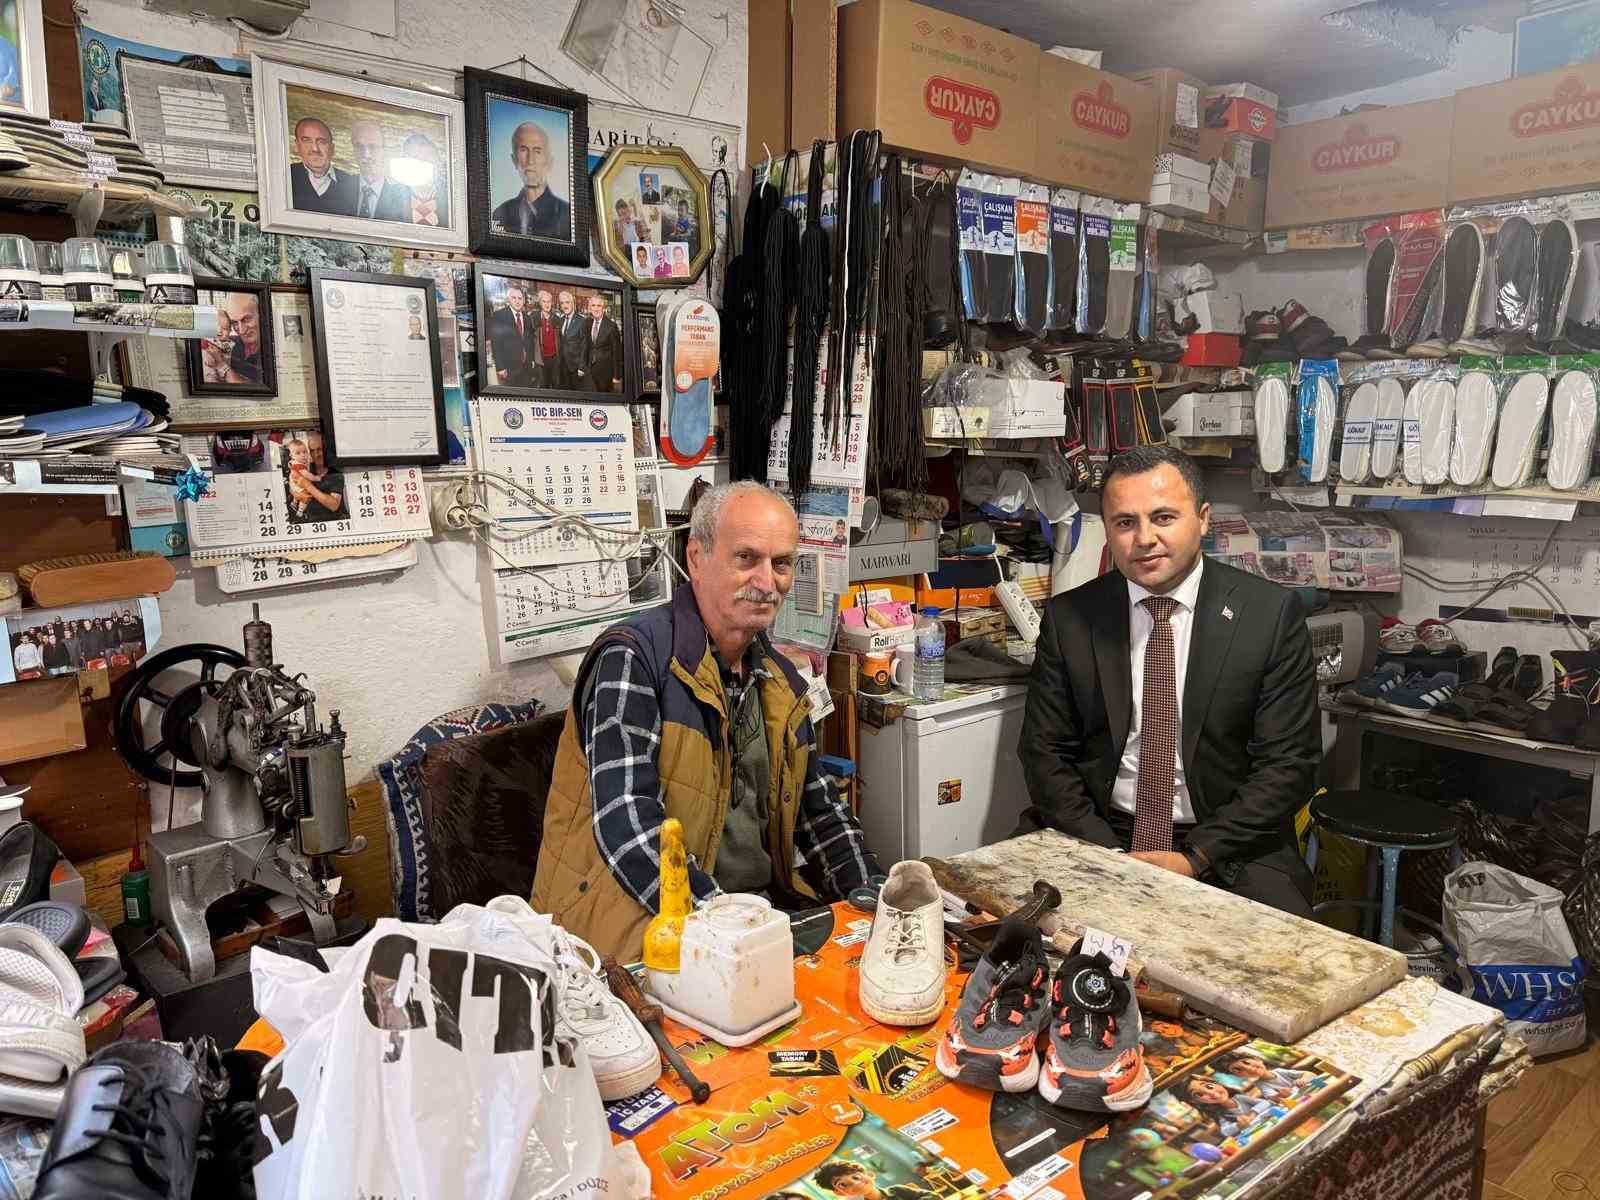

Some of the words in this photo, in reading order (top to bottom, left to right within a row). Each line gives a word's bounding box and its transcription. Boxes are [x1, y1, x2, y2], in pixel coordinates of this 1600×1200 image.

[1517, 100, 1600, 136] ÇAYKU
[1111, 224, 1136, 235] ALIŞKAN
[854, 384, 864, 392] 22
[854, 423, 860, 431] 5
[849, 433, 860, 441] 12
[818, 442, 827, 450] 17
[768, 459, 776, 467] 27
[817, 453, 827, 461] 24
[847, 454, 857, 463] 26
[362, 472, 370, 481] 4
[385, 470, 393, 480] 5
[408, 469, 416, 479] 6
[507, 466, 513, 474] 3
[263, 488, 272, 499] 7
[358, 484, 371, 494] 11
[382, 483, 396, 493] 12
[404, 482, 417, 491] 13
[258, 502, 273, 512] 14
[359, 497, 373, 506] 18
[383, 495, 396, 504] 19
[405, 494, 420, 504] 20
[259, 514, 274, 524] 21
[360, 508, 375, 518] 25
[383, 506, 398, 516] 26
[407, 504, 421, 514] 27
[260, 527, 277, 537] 28
[286, 525, 302, 535] 29
[312, 523, 327, 534] 30
[337, 521, 351, 531] 31
[252, 558, 267, 569] 21
[860, 553, 912, 570] MARWARI
[252, 571, 268, 582] 28
[278, 568, 293, 579] 29
[302, 564, 318, 575] 30
[874, 636, 889, 648] Roll
[658, 1090, 811, 1182] ATOM
